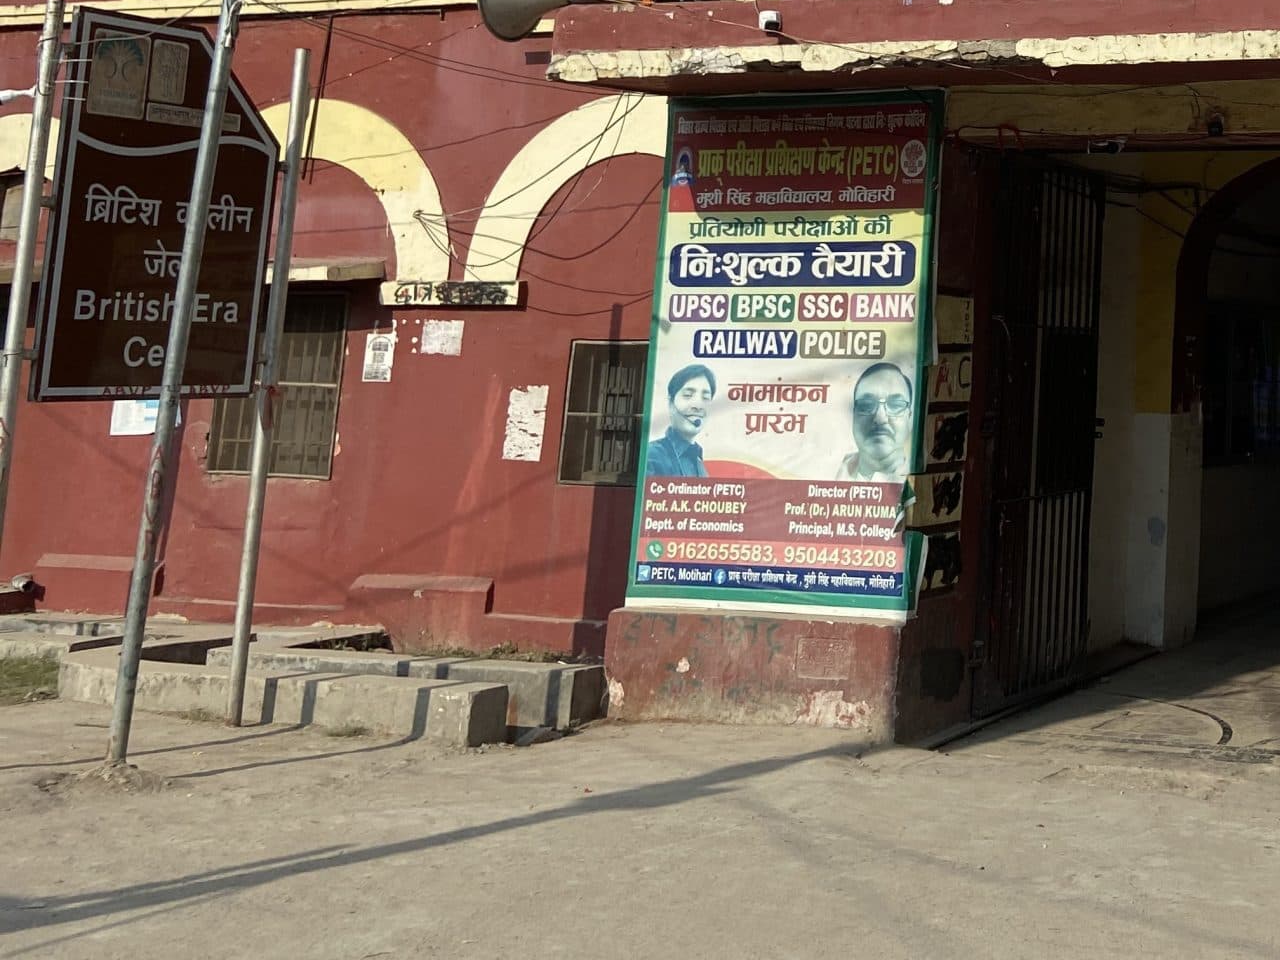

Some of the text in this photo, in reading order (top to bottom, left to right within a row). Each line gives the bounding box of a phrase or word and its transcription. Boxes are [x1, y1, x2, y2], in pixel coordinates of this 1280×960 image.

[727, 143, 762, 177] परीक्षा
[766, 140, 815, 177] प्रशिक्षण
[818, 139, 846, 176] केन्द्र
[847, 144, 899, 182] (PETC)
[85, 183, 162, 226] ब्रिटिश
[697, 187, 722, 209] मुंशी
[727, 188, 751, 205] सिंह
[839, 186, 896, 202] मोतिहारी
[689, 215, 892, 239] प्रतियोगी परीक्षाओं की
[812, 242, 905, 279] तैयारी
[74, 289, 238, 323] British Era
[672, 294, 915, 318] UPSC BPSC SSC BANK
[700, 331, 881, 355] RAILWAY POLICE
[728, 377, 830, 404] नामांकन
[745, 407, 808, 435] प्रारंभ
[668, 482, 711, 496] Ordinator
[713, 483, 745, 498] (PETC)
[808, 485, 882, 501] Director (PETC)
[646, 499, 747, 514] Prof. A.K. CHOUBEY
[785, 503, 861, 519] Prof. (Dr.) ARUN
[645, 518, 744, 533] Deptt. of Economics
[789, 522, 834, 537] Principal,
[837, 525, 857, 537] M.S.
[667, 542, 897, 568] 9162655583, 9504433208
[652, 567, 712, 581] PETC, Motihari
